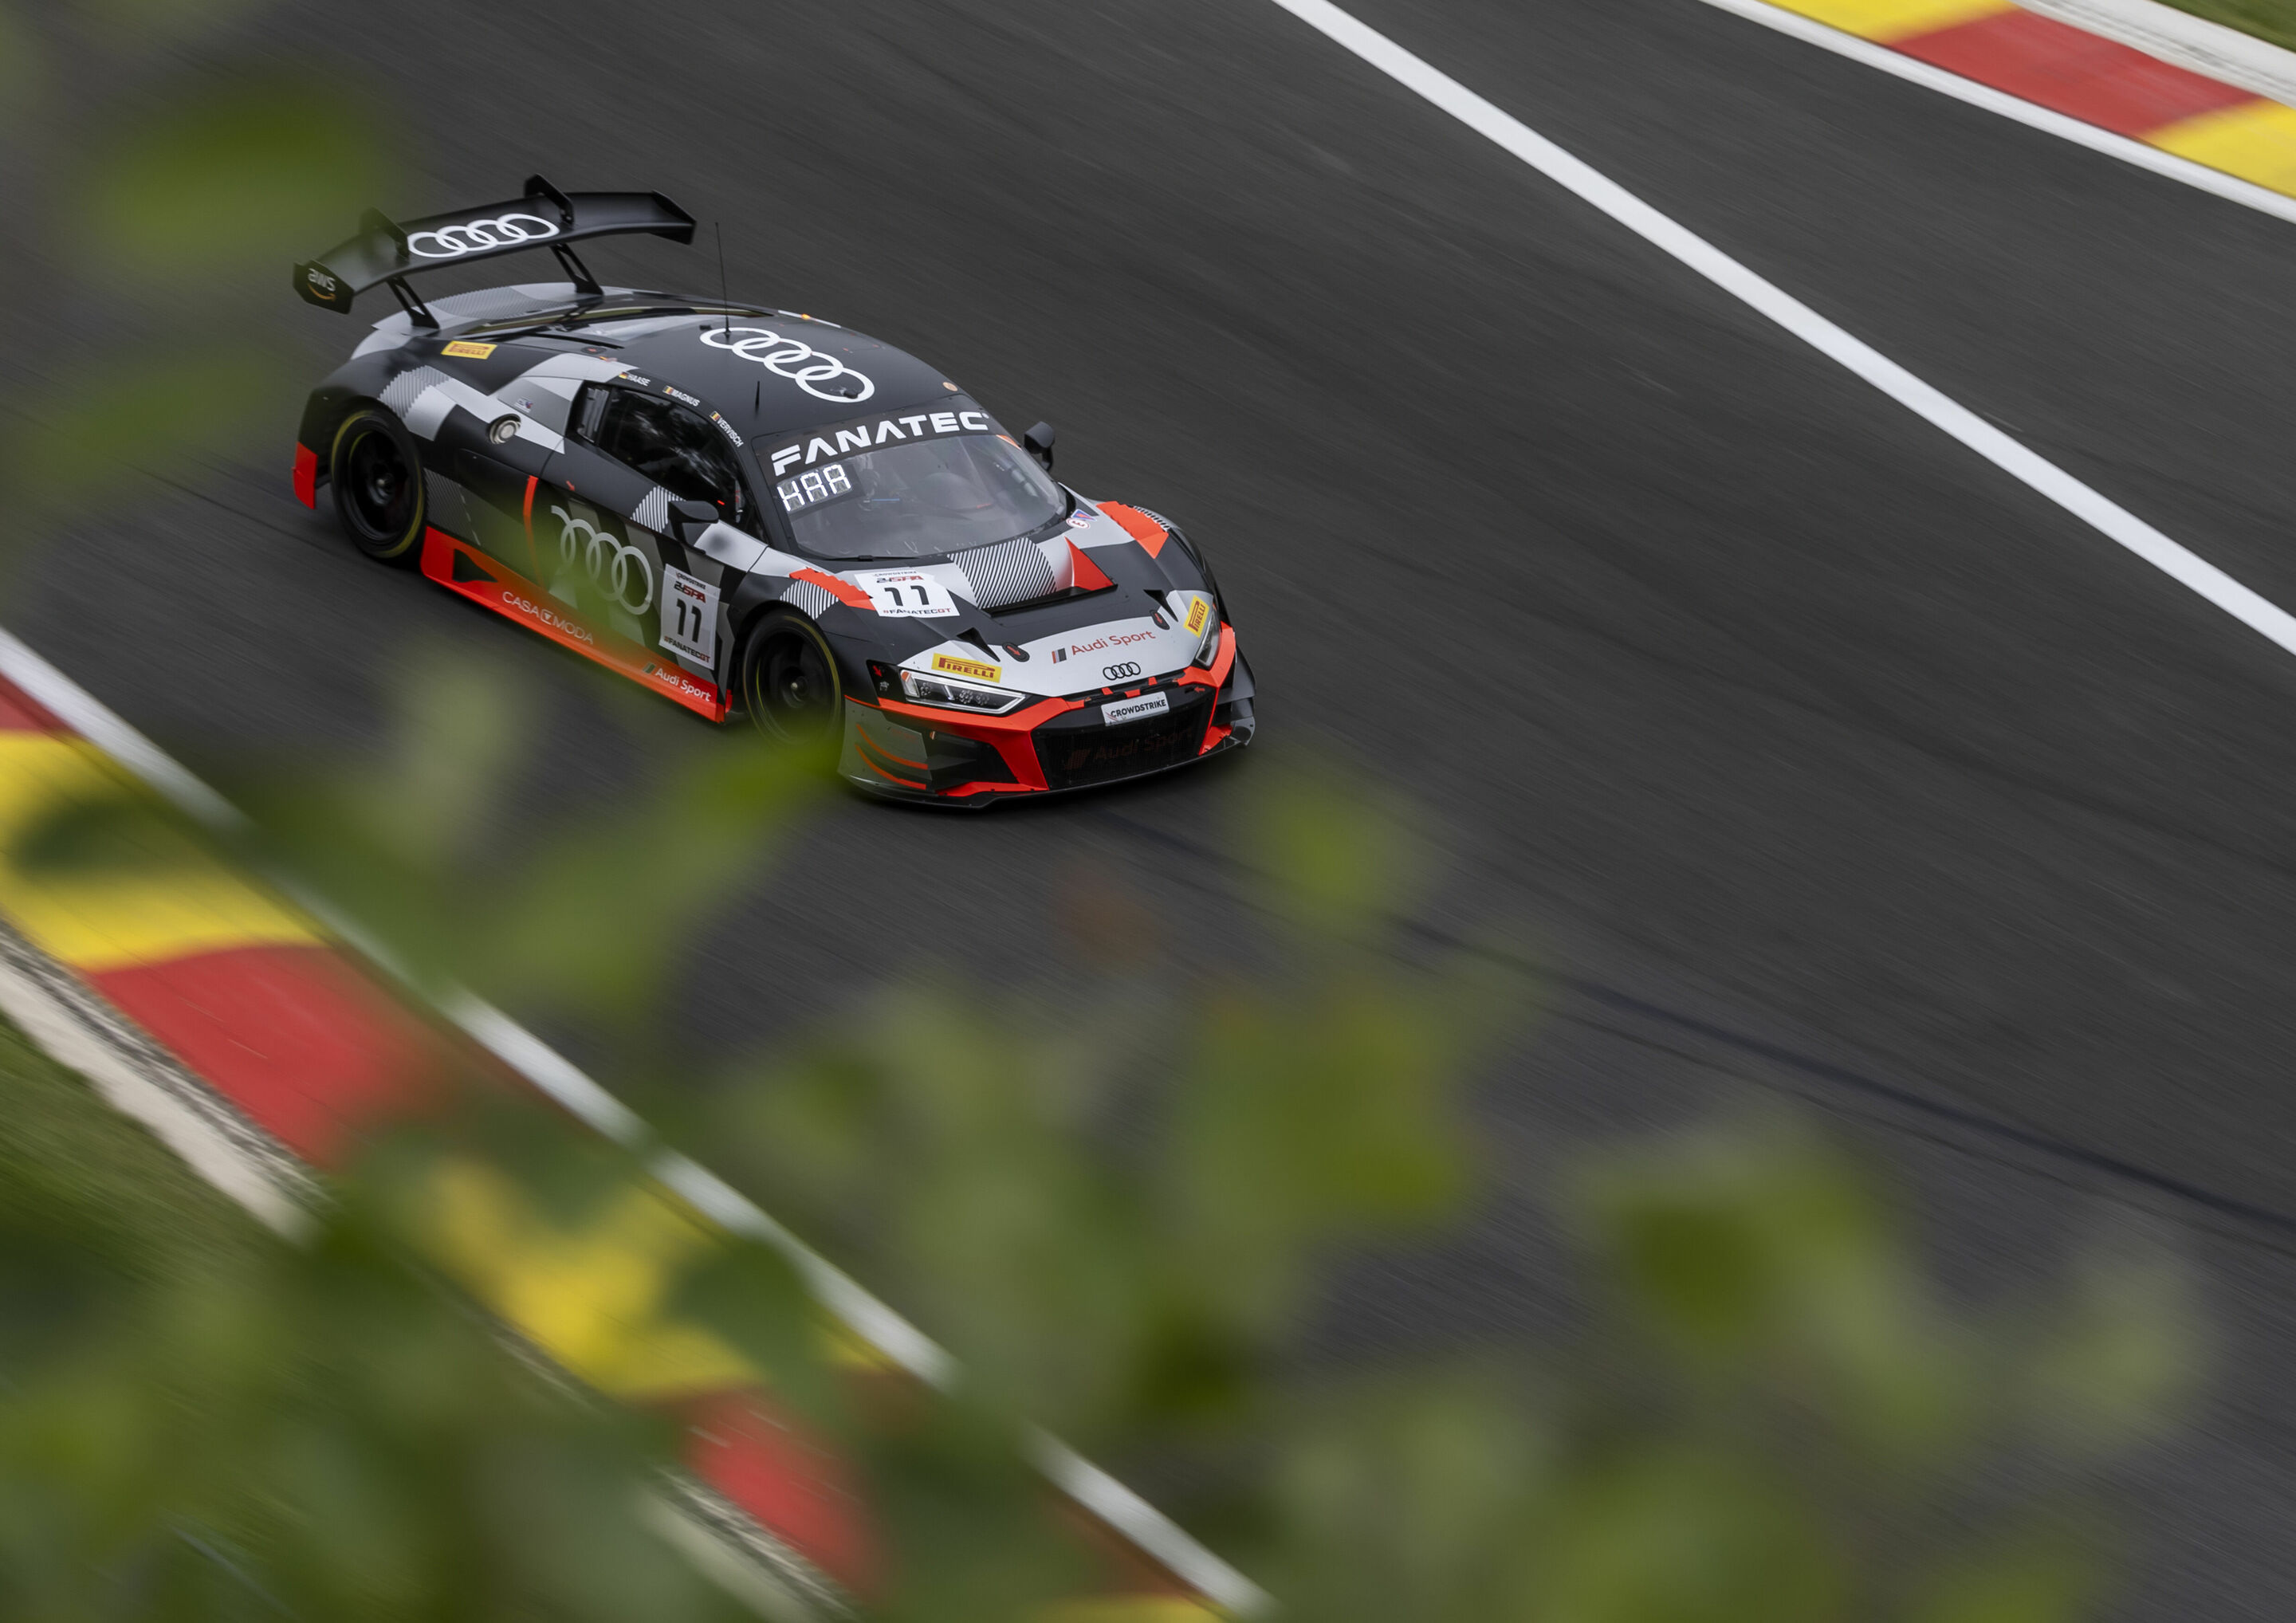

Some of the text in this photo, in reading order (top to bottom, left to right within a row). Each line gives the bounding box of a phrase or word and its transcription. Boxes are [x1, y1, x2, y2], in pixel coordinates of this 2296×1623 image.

[308, 268, 336, 292] aws
[627, 373, 651, 387] HAASE
[671, 390, 701, 407] MAGNUS
[717, 418, 744, 448] VERVISCH
[771, 412, 989, 476] FANATEC
[884, 585, 930, 607] 11
[502, 591, 594, 645] CASA MODA
[676, 598, 702, 643] 11
[1188, 600, 1206, 632] PIRELLI
[664, 635, 711, 663] #FANATECGT
[1071, 631, 1156, 655] Audi Sport
[938, 657, 996, 678] PIRELLI
[655, 668, 711, 701] Audi Sport
[1111, 699, 1166, 717] CROWDSTRIKE
